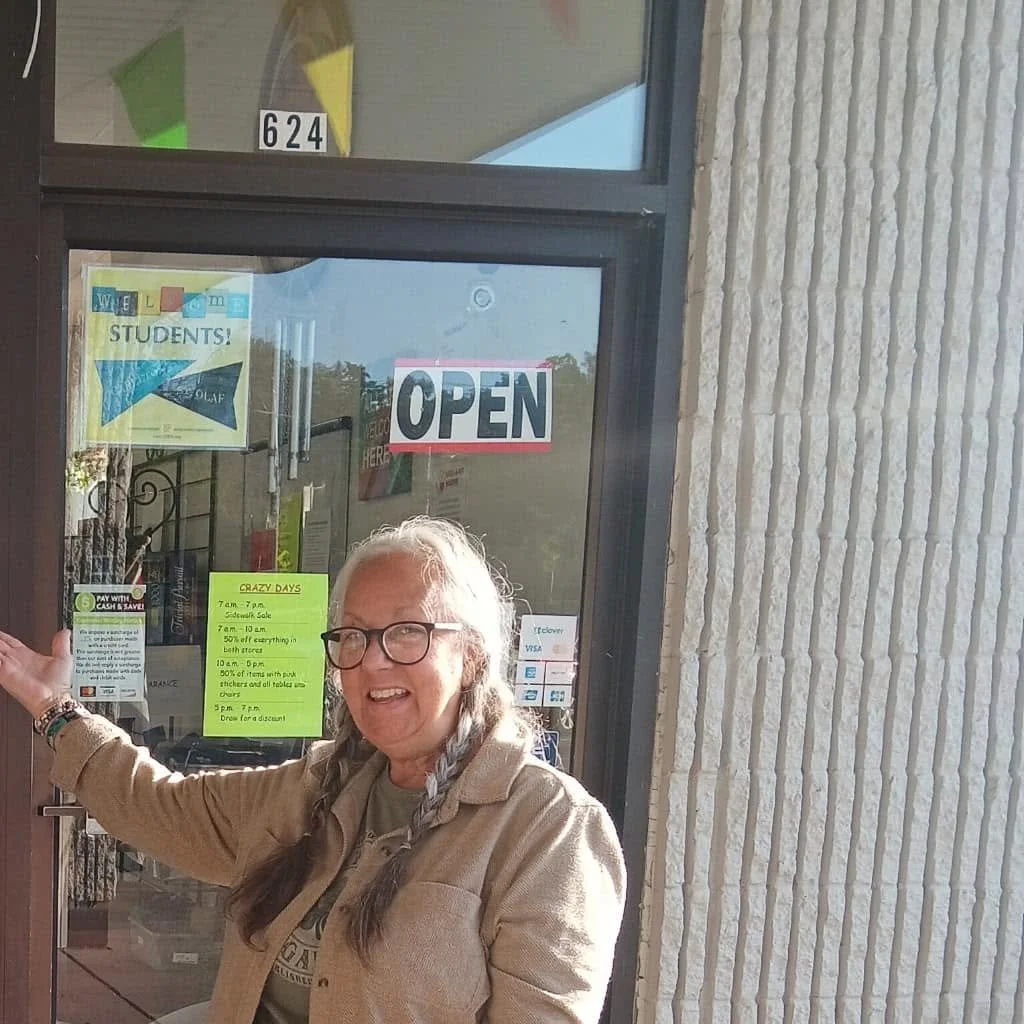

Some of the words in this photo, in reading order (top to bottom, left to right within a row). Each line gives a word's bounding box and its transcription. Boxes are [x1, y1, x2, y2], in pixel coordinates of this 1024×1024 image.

[263, 113, 323, 150] 624
[109, 324, 231, 346] STUDENTS!
[396, 370, 547, 440] OPEN
[239, 583, 271, 592] CRAZY
[276, 584, 302, 592] DAYS
[96, 594, 108, 602] PAY
[110, 594, 130, 602] WITH
[96, 602, 116, 610] CASH
[218, 600, 223, 608] 7
[256, 611, 272, 619] Sale
[223, 635, 239, 643] 50%
[254, 636, 290, 645] everything
[525, 644, 543, 653] VISA
[236, 670, 245, 678] of
[148, 679, 178, 688] ARANCE
[220, 680, 248, 688] stickers
[248, 680, 261, 688] and
[258, 714, 286, 722] discount
